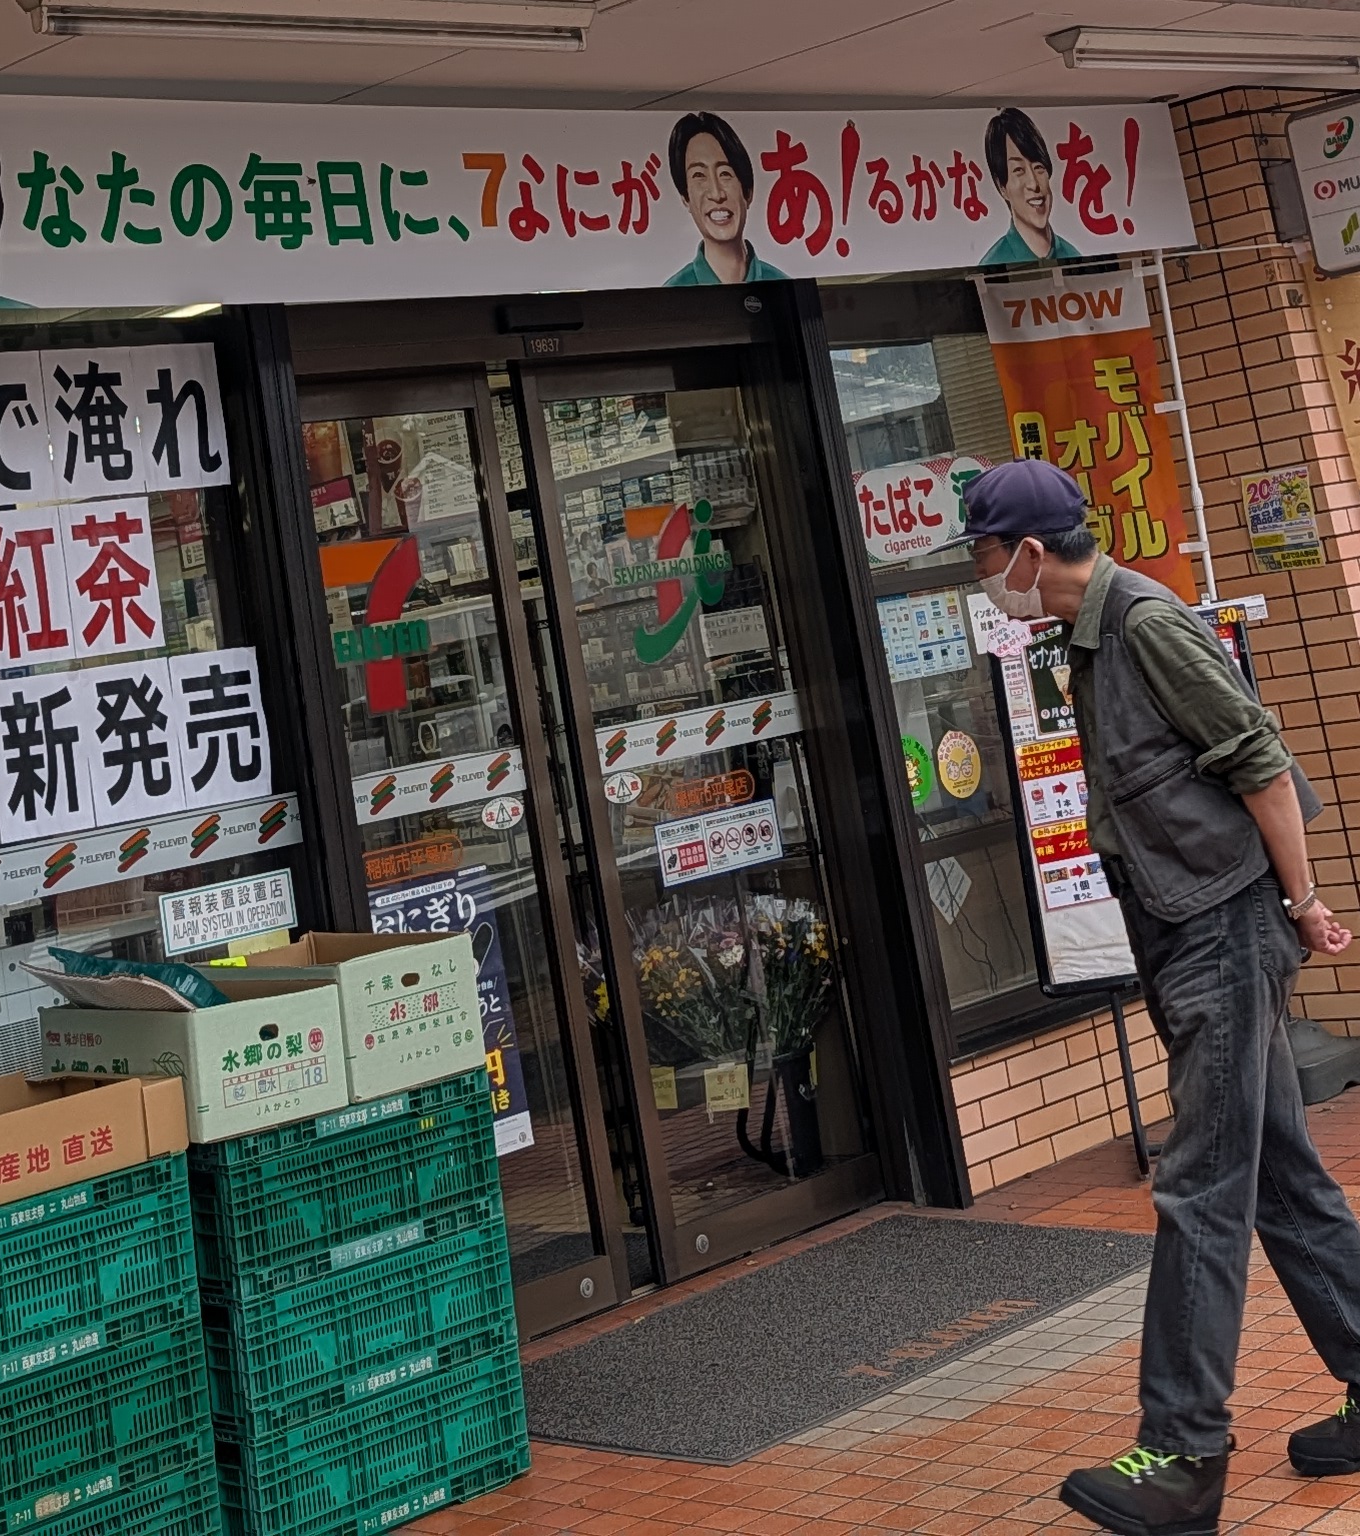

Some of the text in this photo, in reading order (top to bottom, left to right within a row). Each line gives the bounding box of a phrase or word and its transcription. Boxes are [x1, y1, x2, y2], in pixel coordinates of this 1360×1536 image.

[530, 337, 560, 353] 19637
[1093, 356, 1169, 563] モバイル
[859, 476, 943, 539] たばこ
[884, 534, 933, 556] cigarette
[171, 878, 283, 921] 警報装置設置店
[173, 900, 288, 941] ALARM SYSTEM IN OPERATION
[222, 1032, 303, 1072] 水郷の梨
[304, 1066, 323, 1085] 18
[256, 1098, 301, 1116] JAかとり
